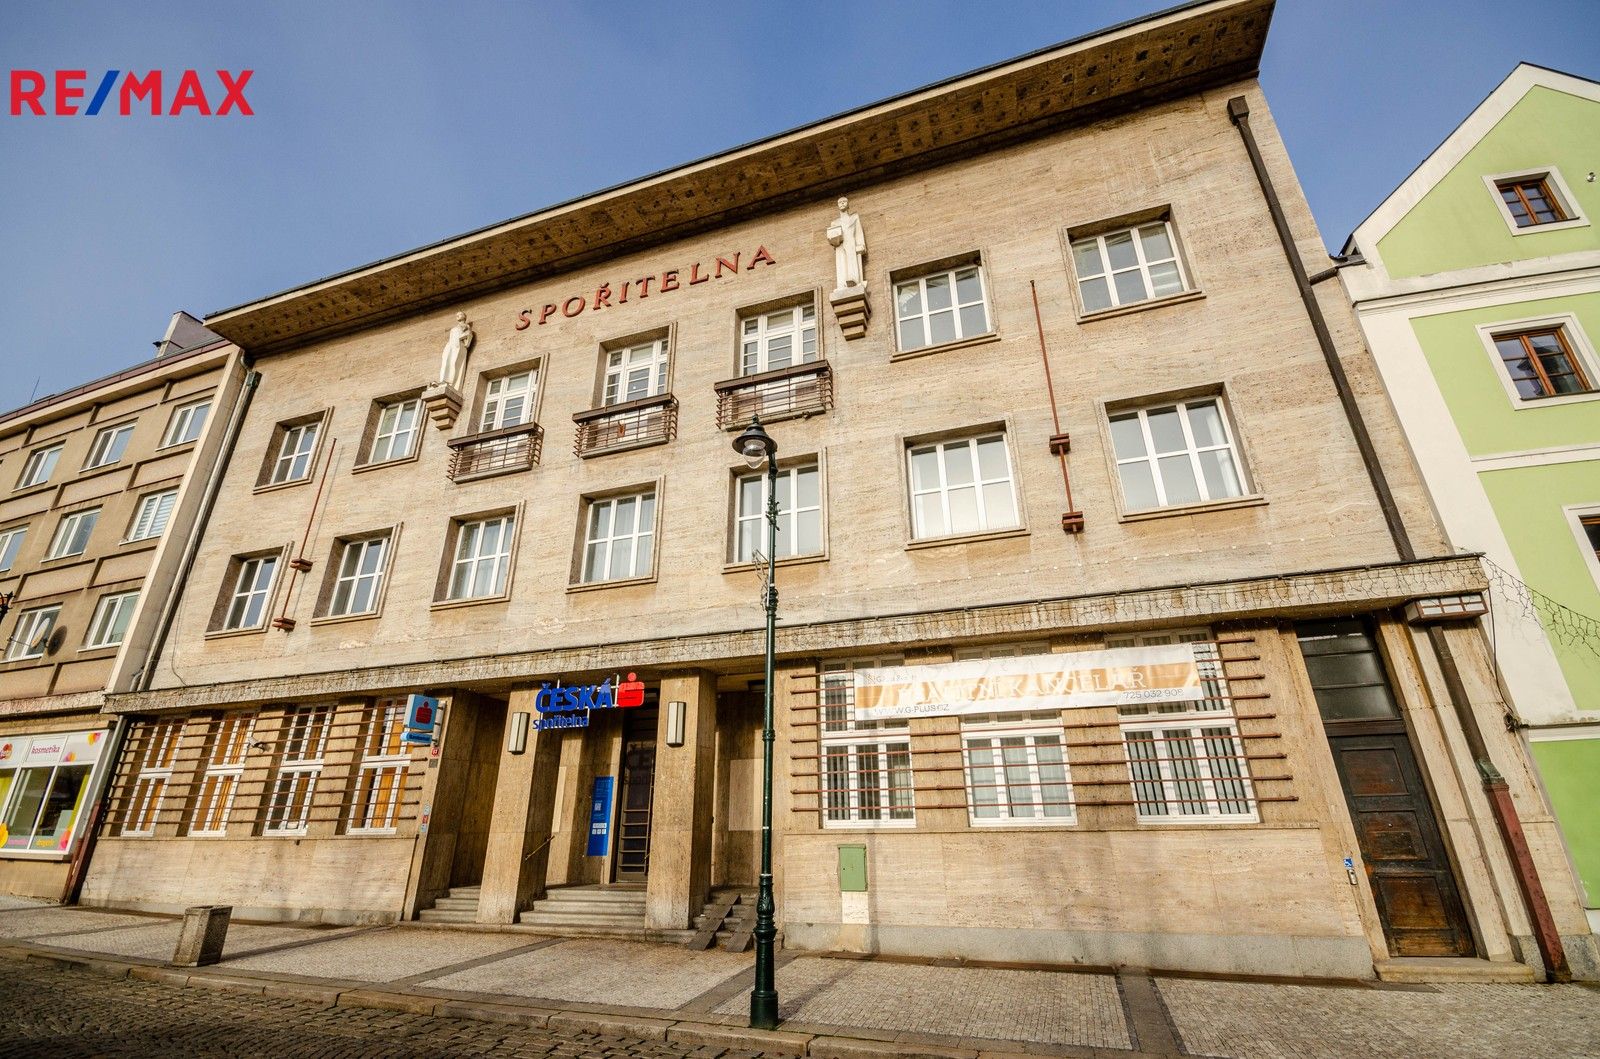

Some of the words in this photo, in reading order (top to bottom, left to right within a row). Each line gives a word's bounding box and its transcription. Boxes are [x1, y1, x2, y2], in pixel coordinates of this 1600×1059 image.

[515, 244, 777, 331] SPOŘITELNA
[535, 678, 614, 713] ČESKÁ
[1124, 691, 1142, 700] 725
[1144, 689, 1162, 699] 032
[533, 713, 590, 732] spořitelna
[31, 745, 60, 755] kosmetika
